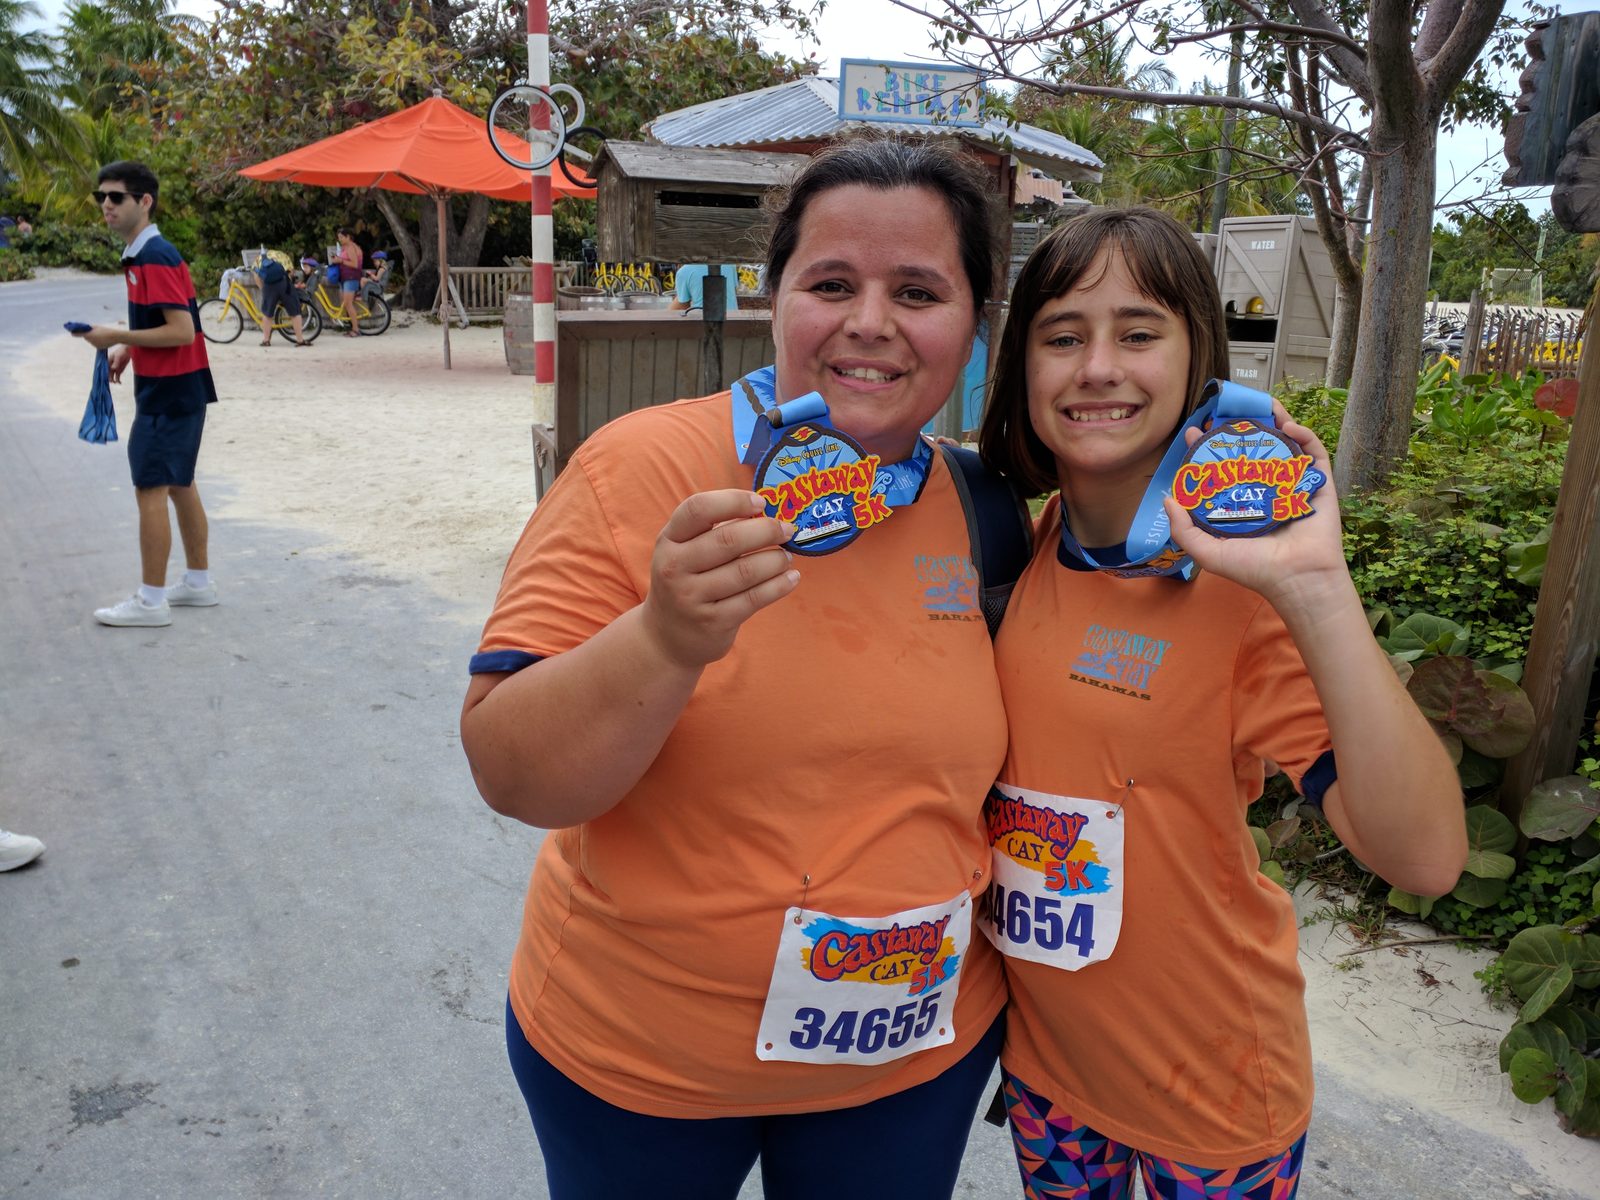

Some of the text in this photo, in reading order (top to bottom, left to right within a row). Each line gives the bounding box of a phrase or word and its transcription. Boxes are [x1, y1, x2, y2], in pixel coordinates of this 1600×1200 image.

[885, 72, 947, 94] BIKE
[856, 87, 968, 117] RENTAL
[1251, 240, 1276, 250] WATER
[1236, 368, 1258, 379] TRASH
[1172, 455, 1313, 510] Castaway
[1231, 488, 1267, 502] CAY
[812, 497, 845, 519] CAY
[852, 494, 893, 529] 5K
[1272, 491, 1315, 521] 5K
[1069, 673, 1151, 701] BAHAMAS
[1007, 838, 1045, 863] CAY
[1044, 860, 1094, 892] 5K
[984, 882, 1095, 958] 4654
[810, 914, 951, 982] Castaway
[870, 959, 915, 981] CAY
[908, 956, 947, 995] 5K
[789, 991, 942, 1054] 34655
